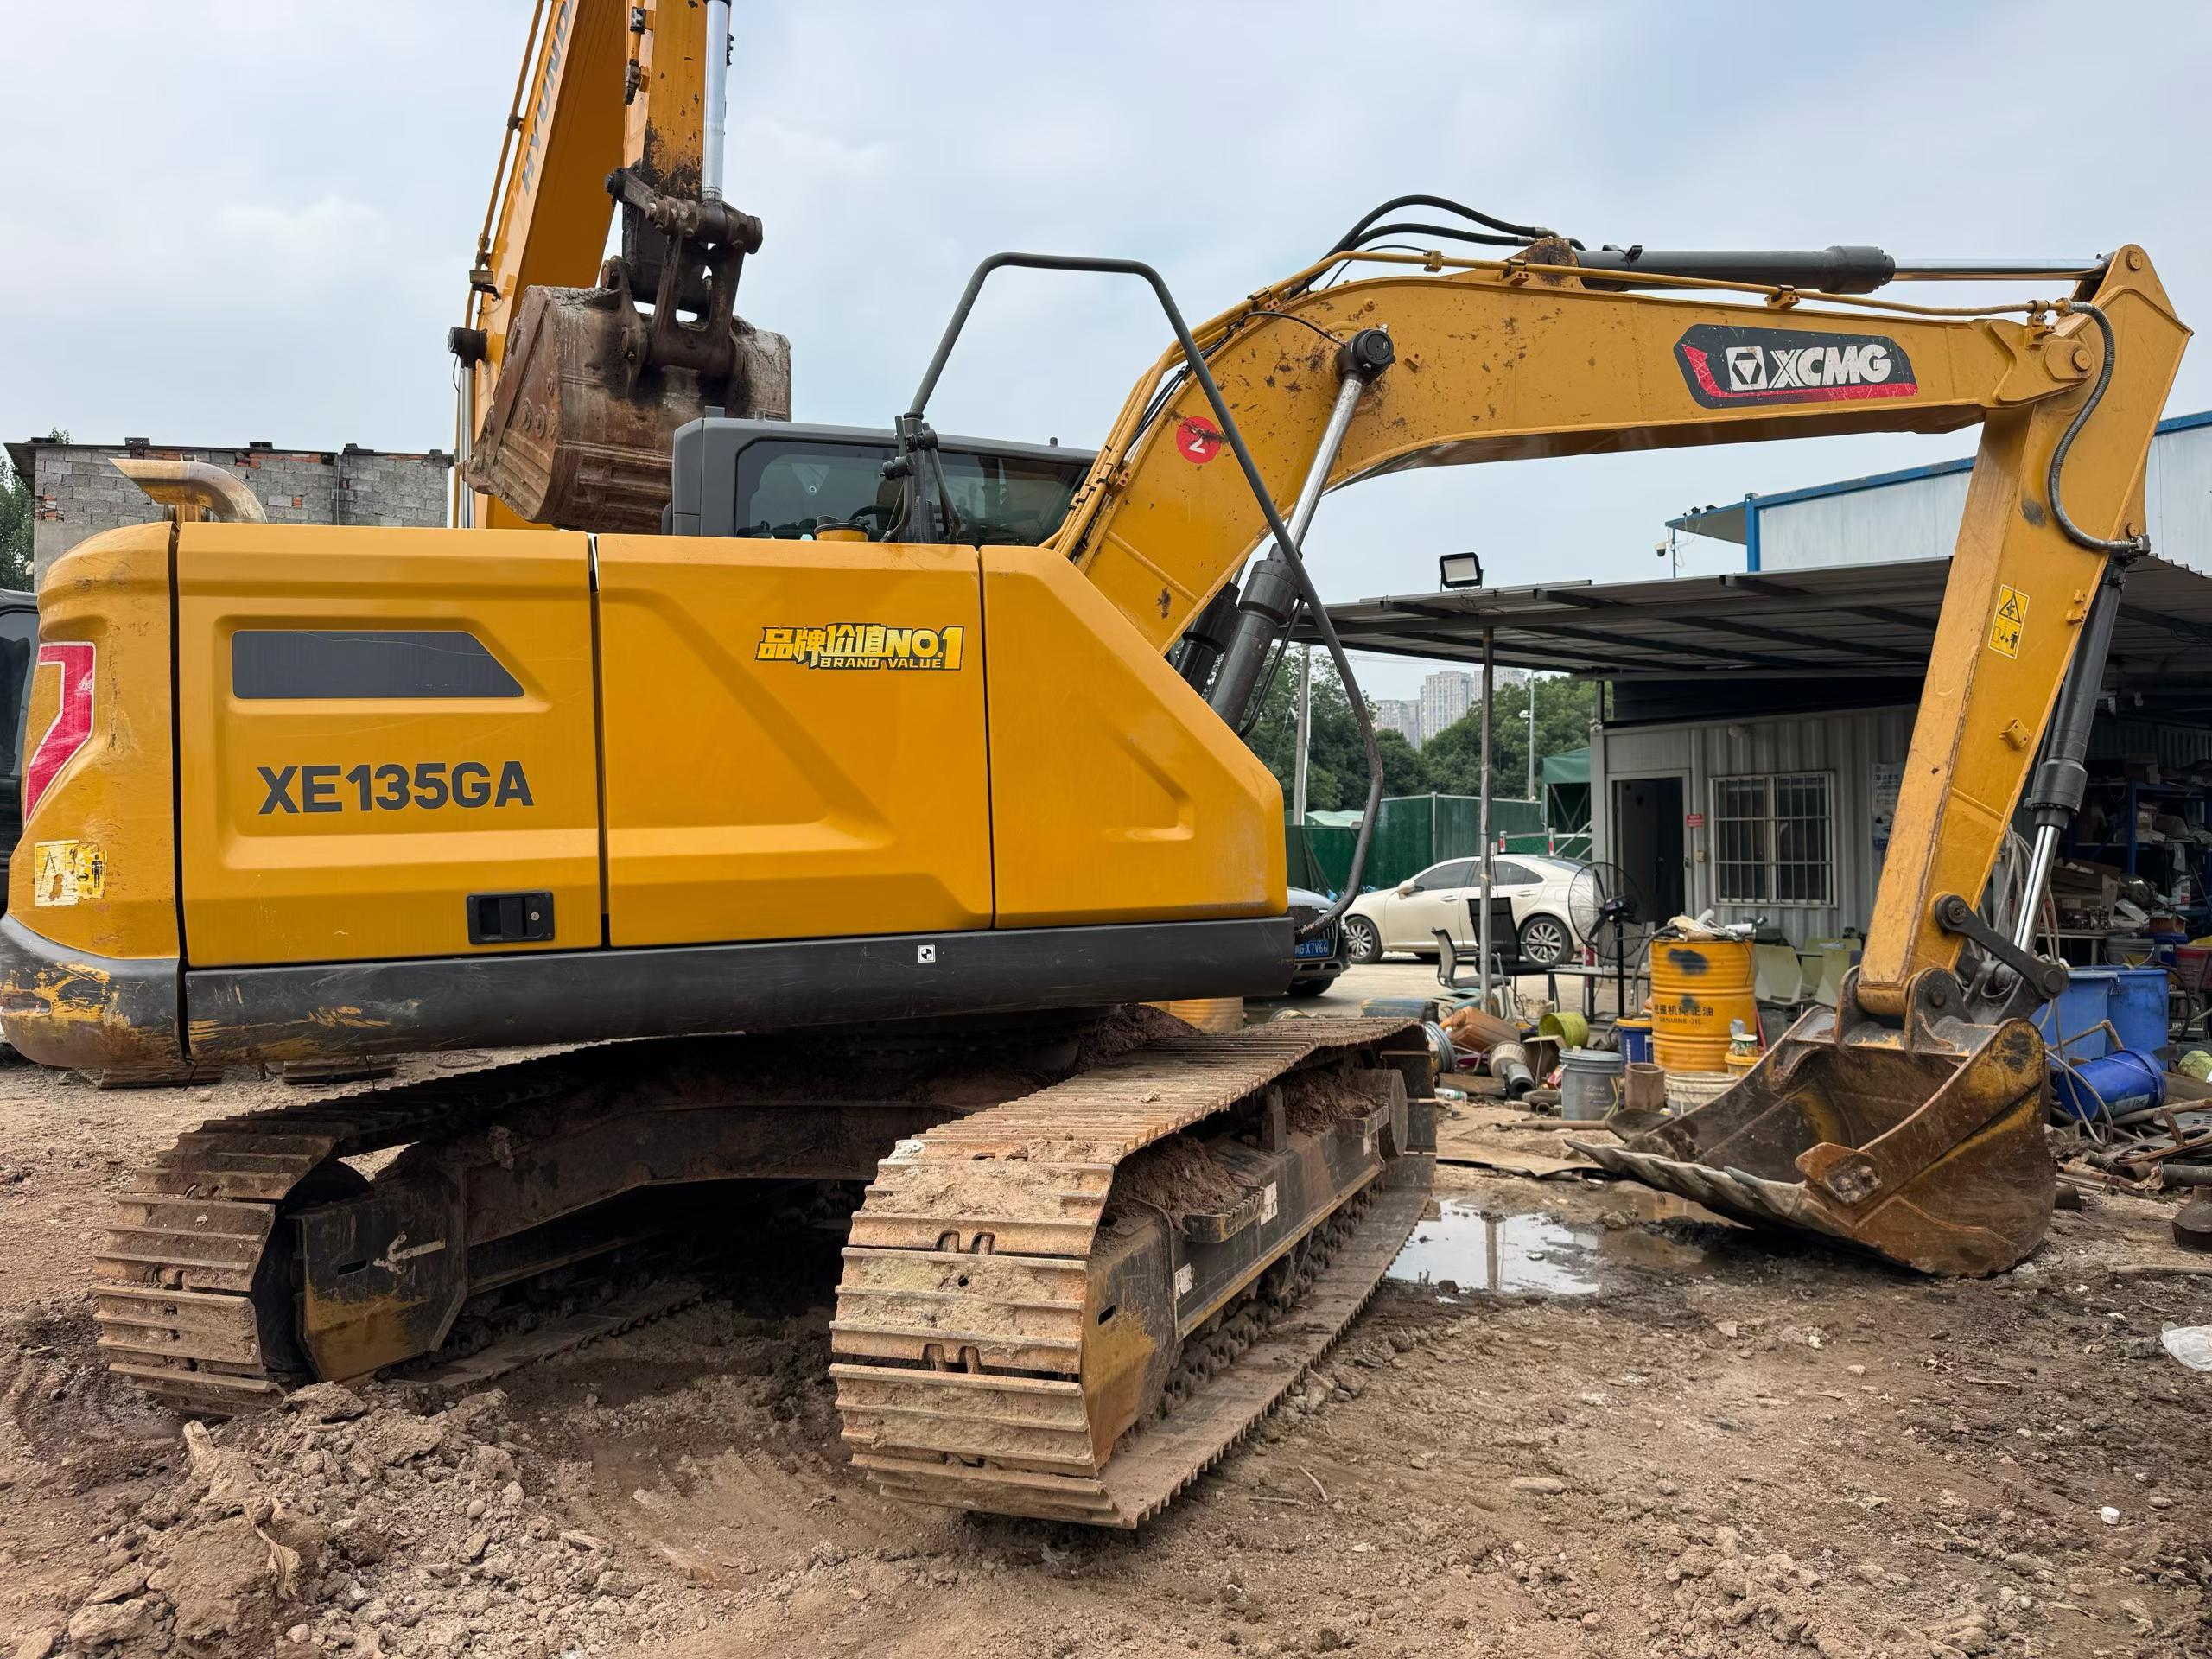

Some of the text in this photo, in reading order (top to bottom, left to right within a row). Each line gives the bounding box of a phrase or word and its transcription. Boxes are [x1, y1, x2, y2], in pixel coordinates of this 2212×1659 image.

[1769, 344, 1891, 388] XCMG
[820, 658, 942, 668] BRAND VALUE
[257, 760, 535, 815] XE135GA
